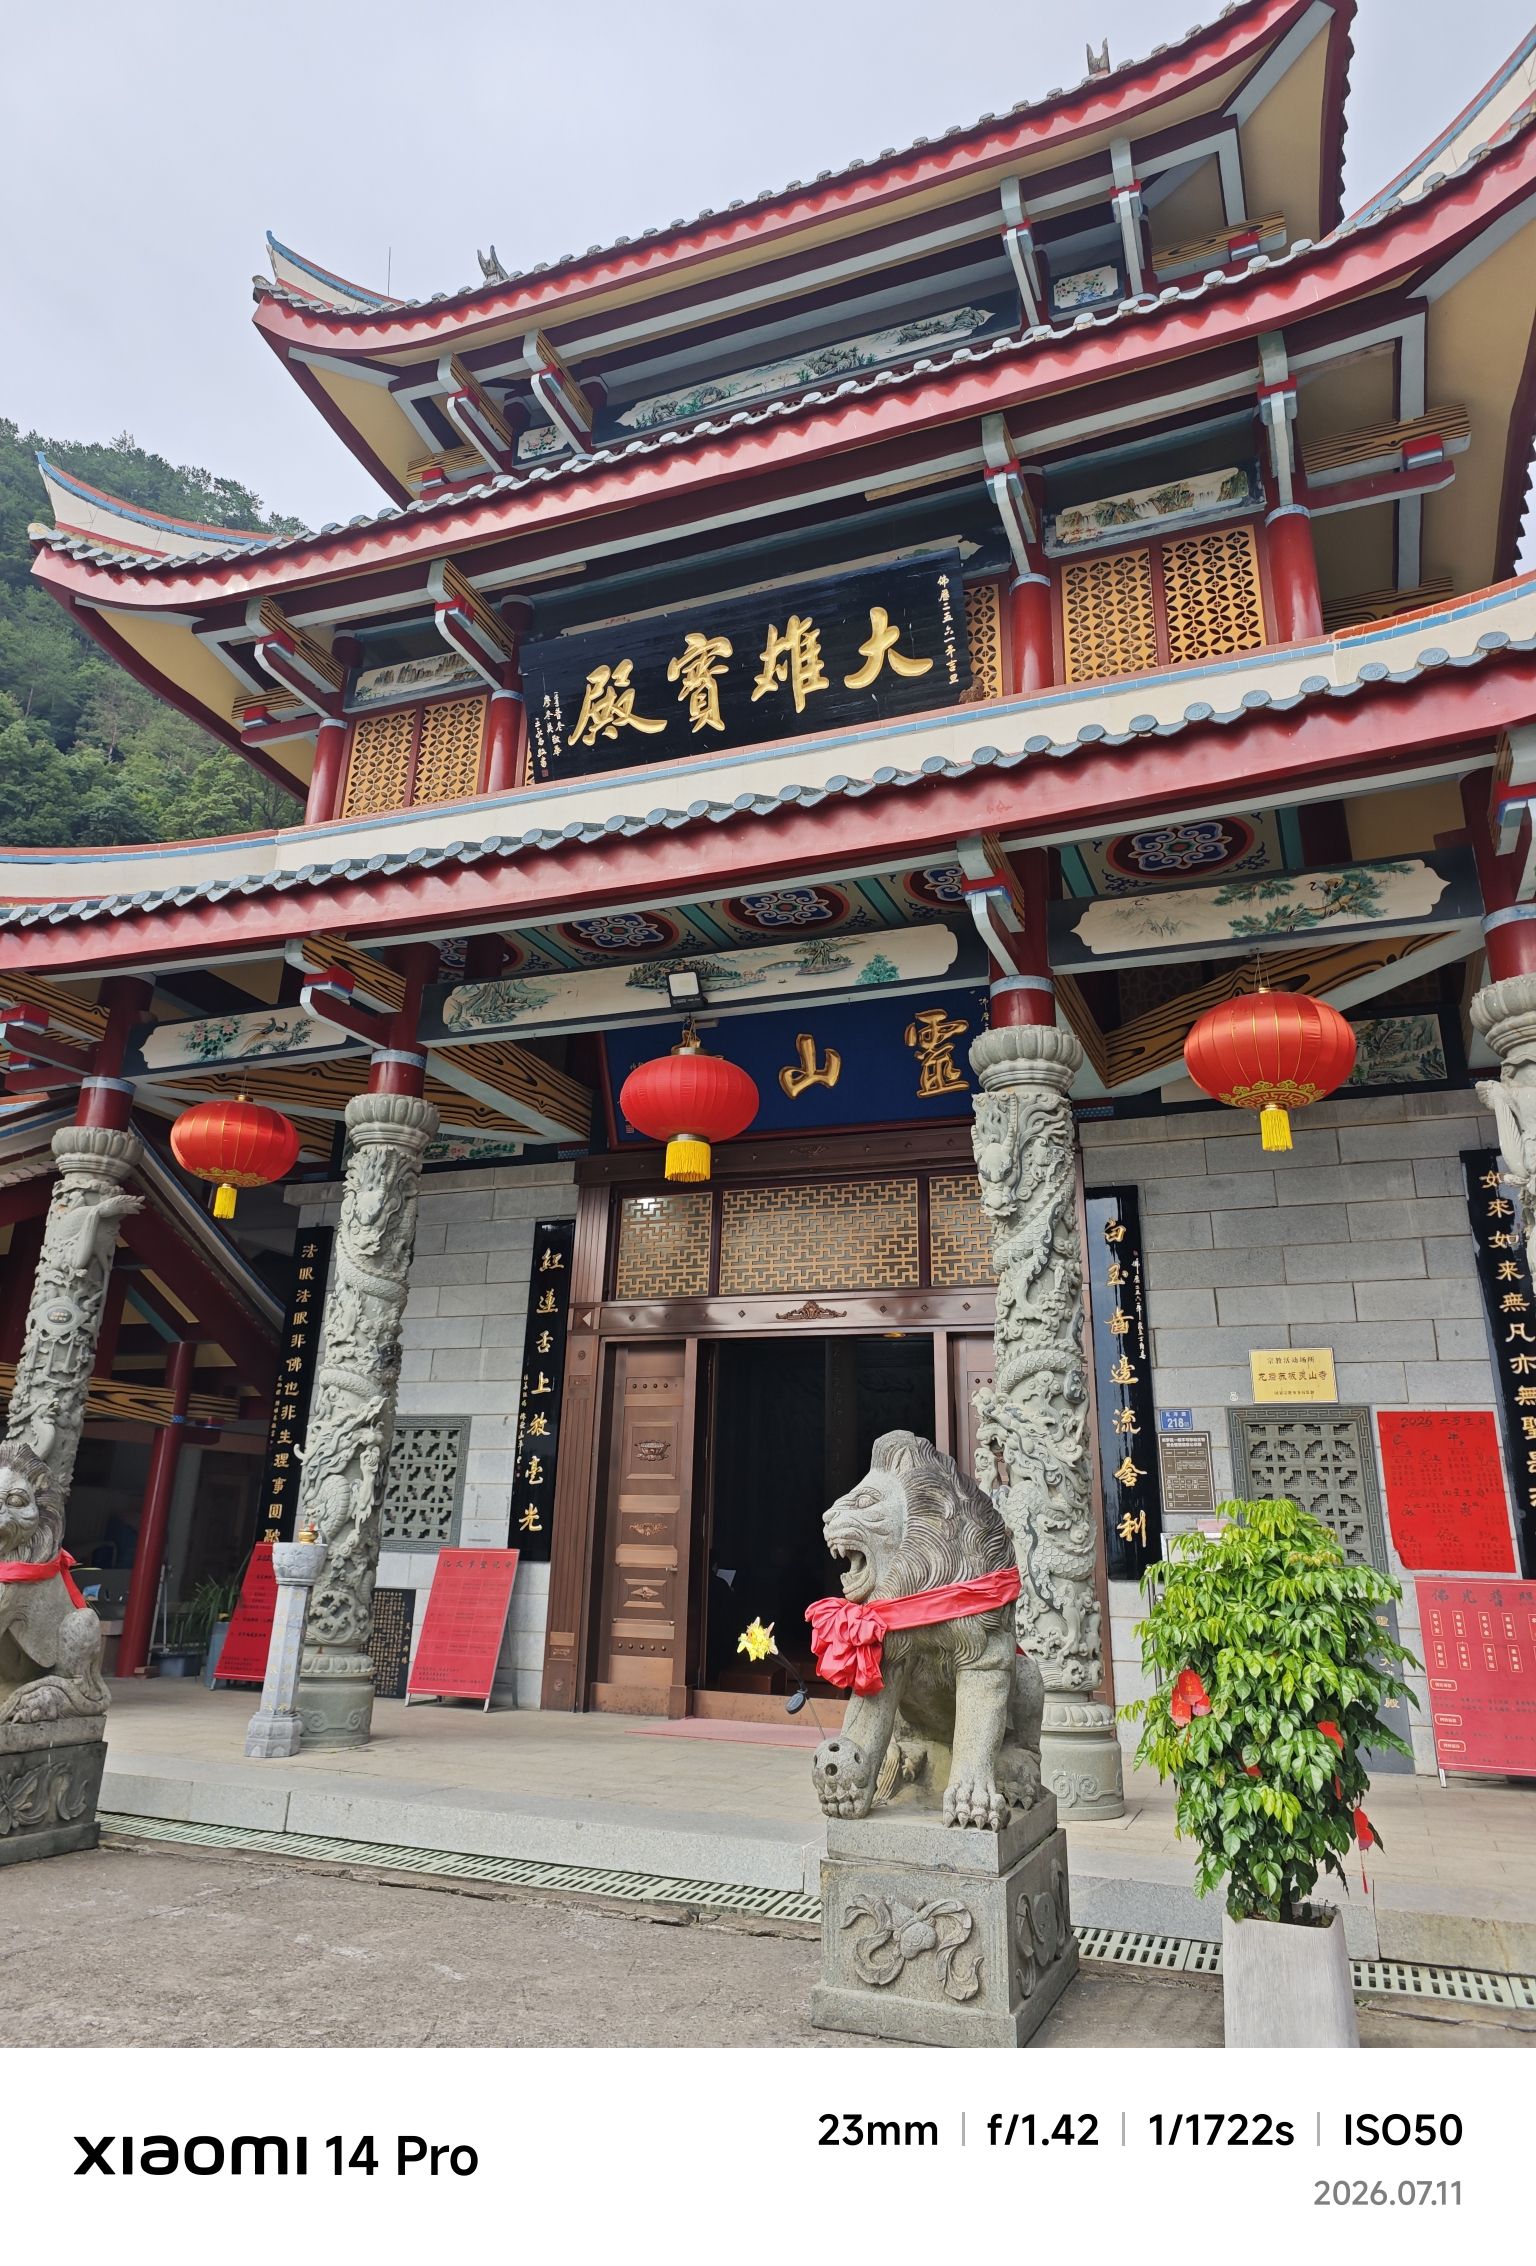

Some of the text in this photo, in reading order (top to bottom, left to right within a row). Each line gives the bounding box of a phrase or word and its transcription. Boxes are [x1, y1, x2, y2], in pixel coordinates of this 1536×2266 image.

[568, 606, 933, 746] 大雄寶殿
[518, 1247, 565, 1532] 紅蓮舌上放毫光
